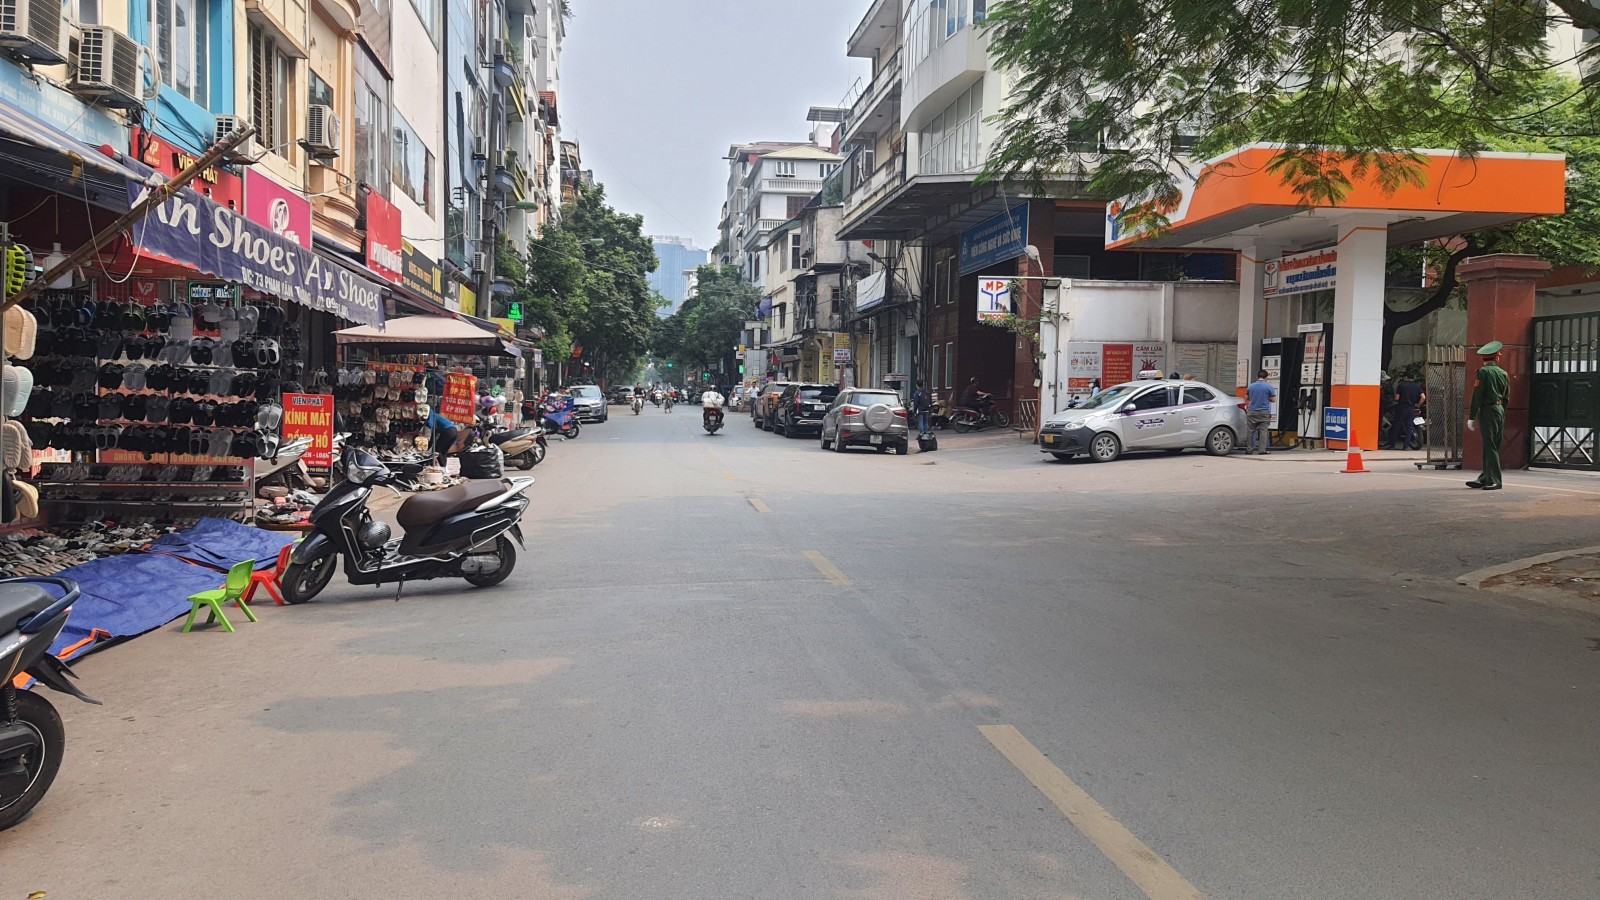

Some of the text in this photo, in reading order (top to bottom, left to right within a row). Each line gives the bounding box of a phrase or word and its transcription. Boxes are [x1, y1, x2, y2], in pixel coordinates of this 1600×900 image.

[208, 206, 296, 276] Shoes
[338, 270, 380, 312] Shoes
[254, 271, 264, 288] 73
[284, 407, 331, 427] KÍNH MẮT
